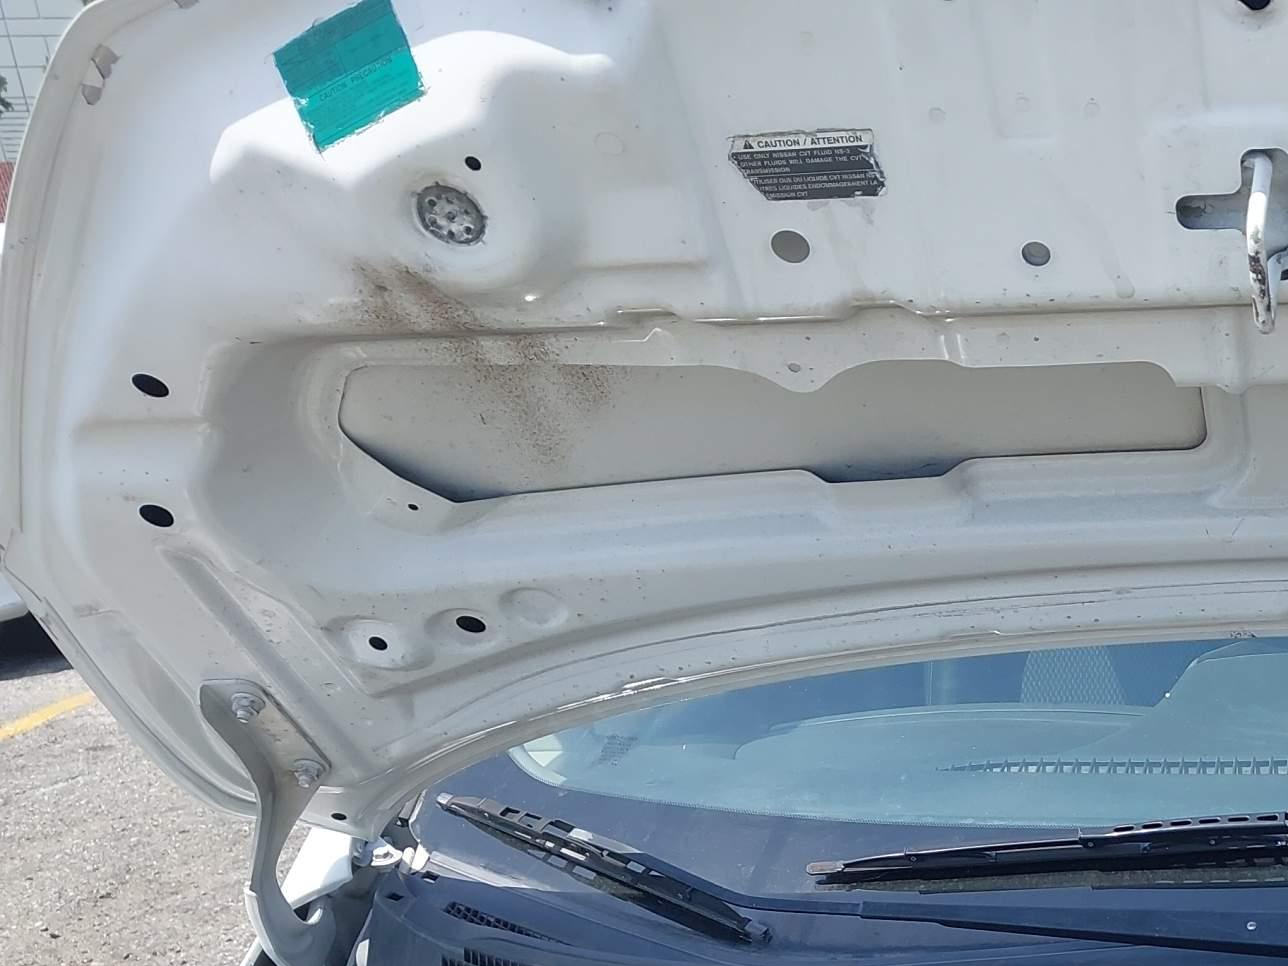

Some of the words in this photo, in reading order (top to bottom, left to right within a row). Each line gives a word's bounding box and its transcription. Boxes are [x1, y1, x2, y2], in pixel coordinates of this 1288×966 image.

[757, 138, 801, 149] CAUTION
[810, 134, 863, 146] ATTENTION
[805, 156, 832, 164] DAMAGE
